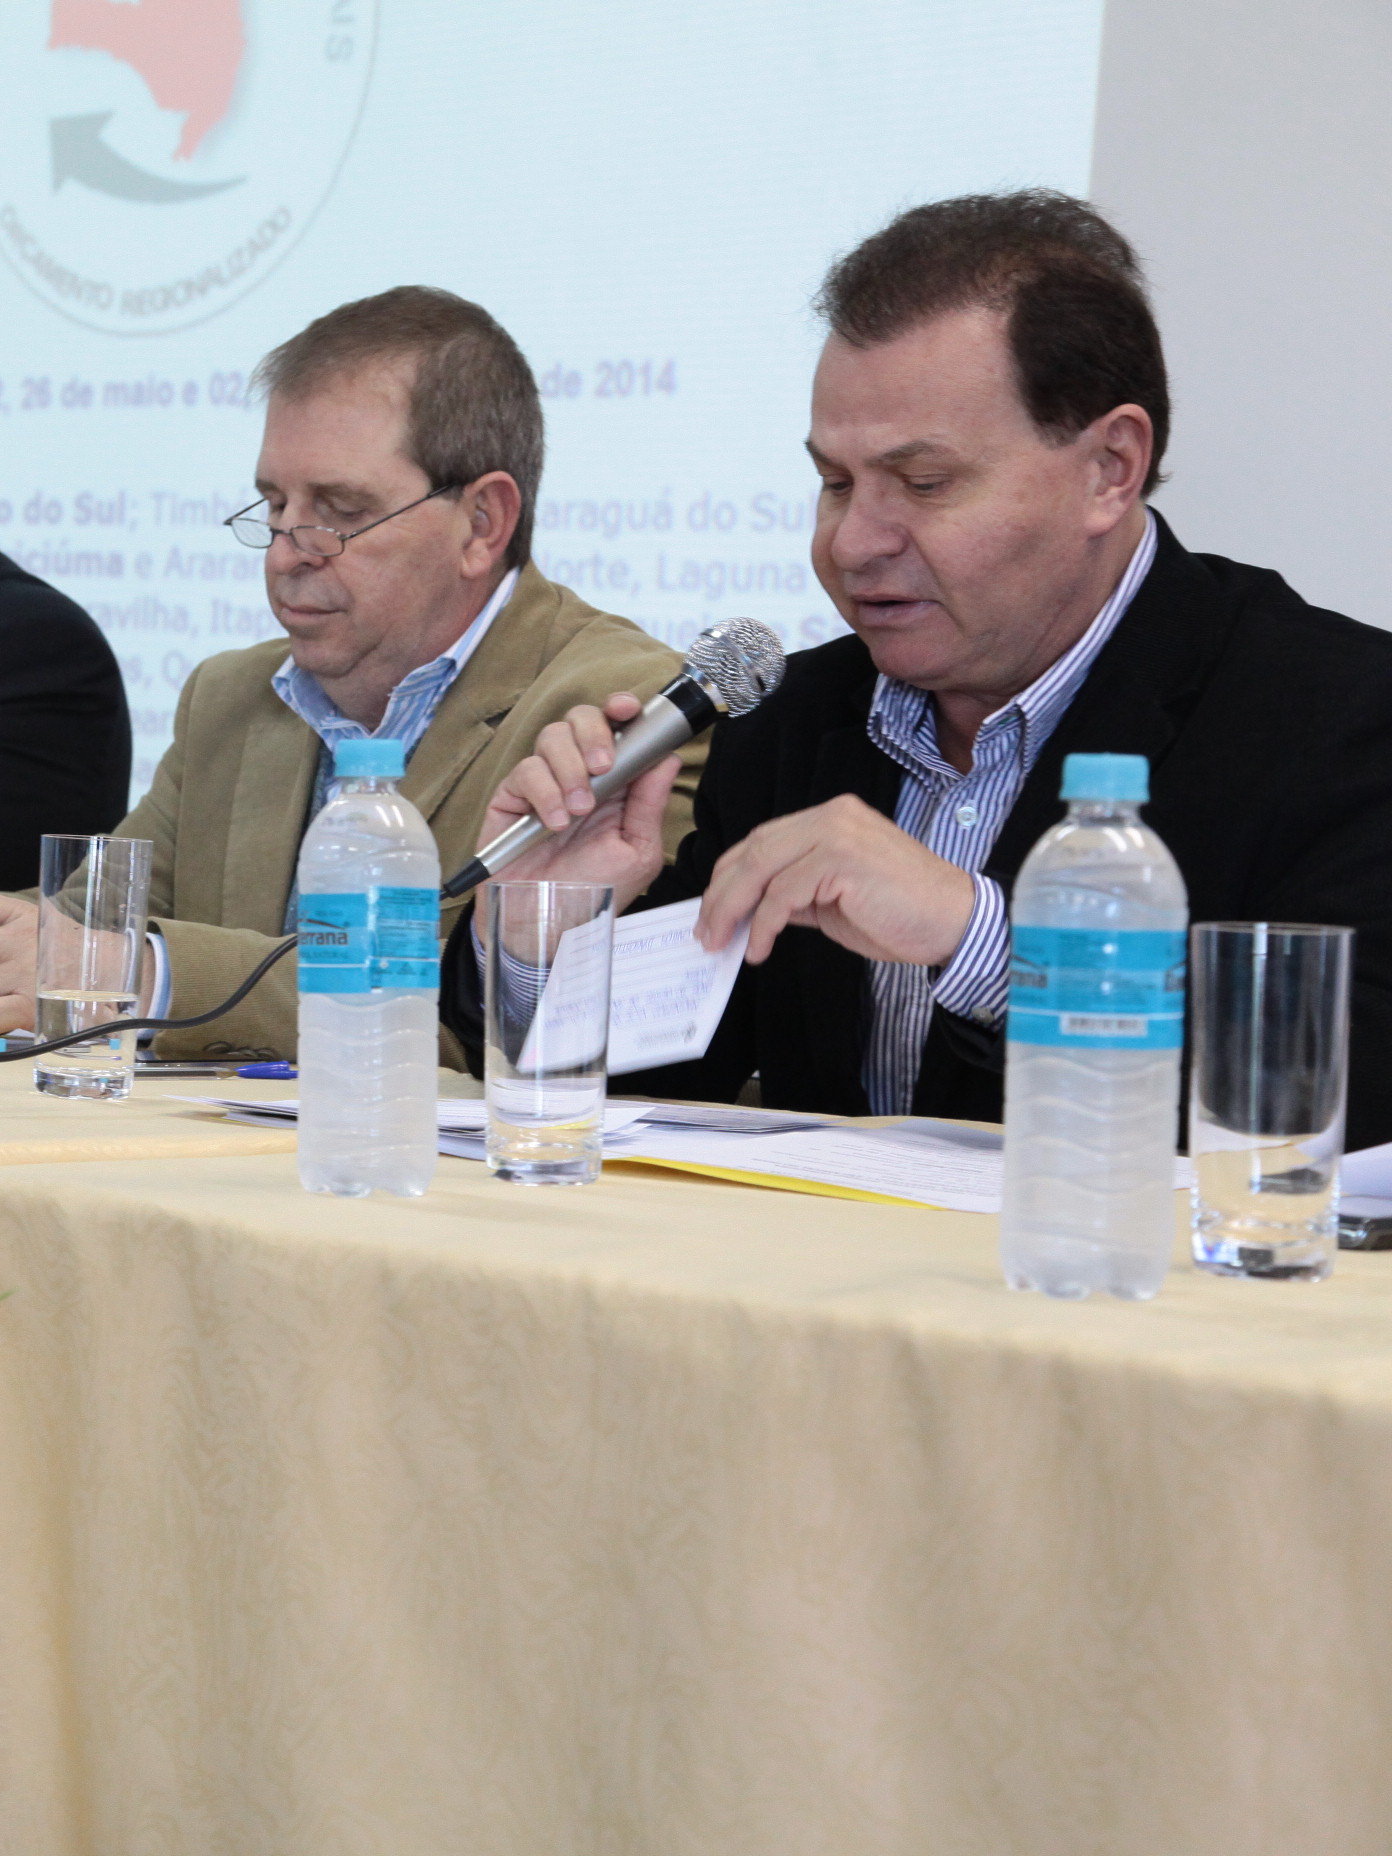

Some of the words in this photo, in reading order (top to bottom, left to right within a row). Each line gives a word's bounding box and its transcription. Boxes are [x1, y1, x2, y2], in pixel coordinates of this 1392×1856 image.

[59, 373, 95, 410] de
[102, 371, 175, 409] maio
[181, 379, 199, 407] e
[539, 362, 583, 400] de
[594, 359, 678, 399] 2014
[23, 487, 64, 526] do
[539, 487, 675, 540] araguá
[687, 491, 739, 534] do
[134, 553, 153, 579] e
[656, 550, 809, 601] Laguna
